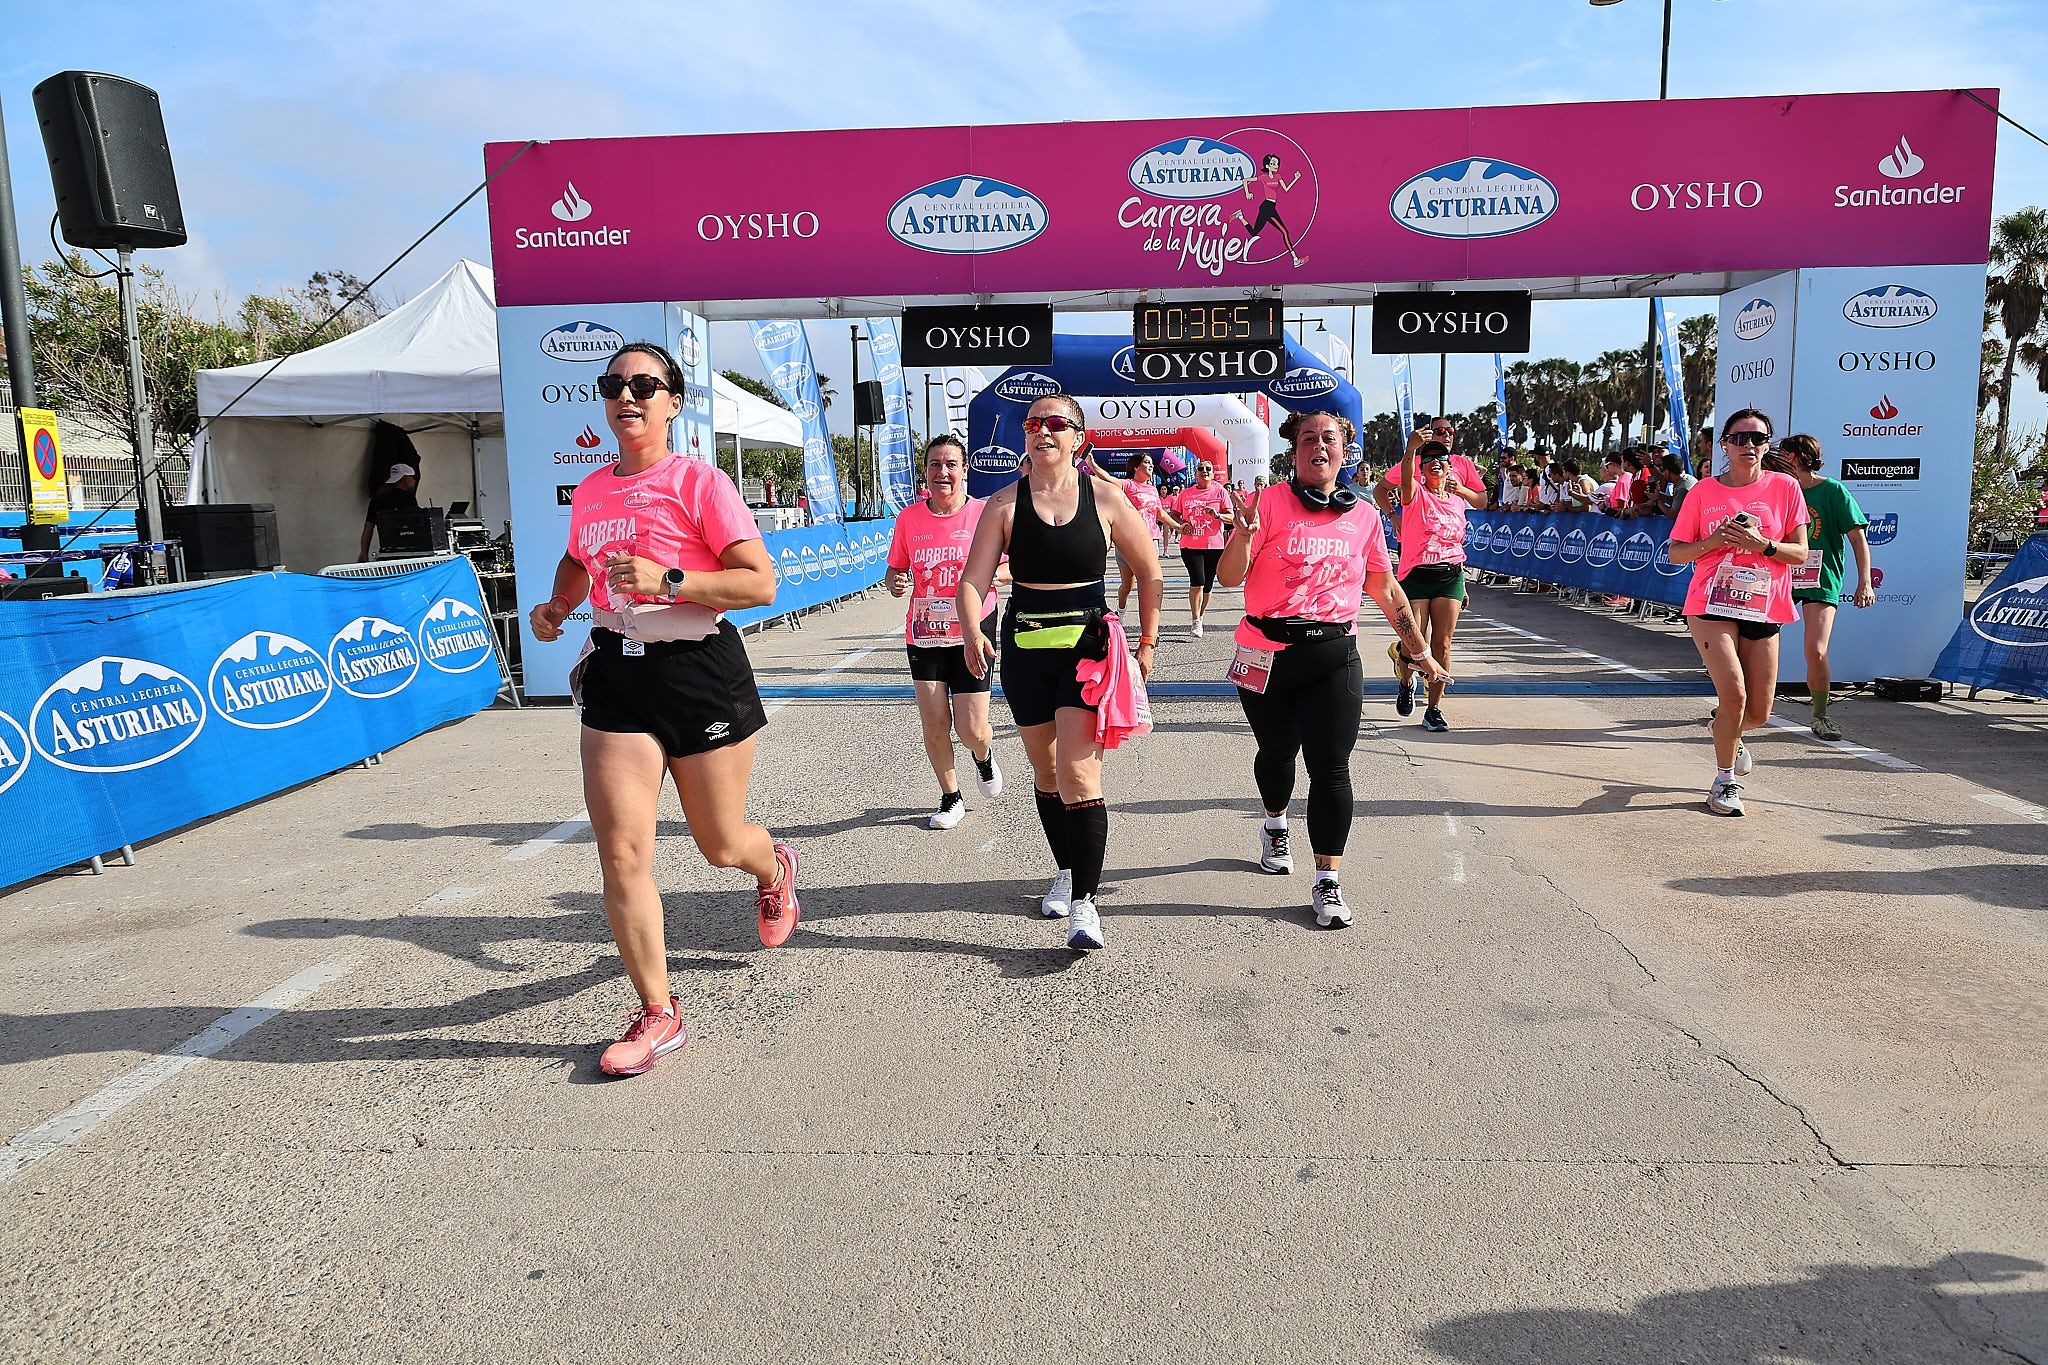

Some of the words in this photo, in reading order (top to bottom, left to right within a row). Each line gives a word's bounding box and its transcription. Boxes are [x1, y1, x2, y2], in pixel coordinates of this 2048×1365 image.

[1157, 158, 1198, 166] CENTRAL
[1201, 157, 1242, 165] LECHERA
[1138, 161, 1246, 185] ASTURIANA
[1428, 187, 1483, 195] CENTRAL
[1487, 184, 1541, 193] LECHERA
[1630, 180, 1763, 212] OYSHO
[1833, 182, 1966, 208] Santander
[923, 203, 974, 211] CENTRAL
[978, 202, 1031, 210] LECHERA
[1117, 196, 1223, 229] Carrera
[1405, 189, 1545, 220] ASTURIANA
[697, 211, 820, 241] OYSHO
[899, 206, 1037, 236] ASTURIANA
[515, 226, 631, 249] Santander
[1143, 230, 1164, 252] de
[1166, 229, 1181, 251] la
[1177, 223, 1261, 276] Mujer
[1849, 301, 1931, 318] ASTURIANA
[1398, 311, 1509, 335] OYSHO
[1737, 314, 1773, 334] ASTURIANA
[547, 338, 620, 353] ASTURIANA
[926, 326, 1031, 349] OYSHO
[1141, 349, 1279, 380] OYSHO
[1731, 357, 1775, 384] OYSHO
[1838, 350, 1937, 372] OYSHO
[542, 384, 605, 404] OYSH
[999, 383, 1057, 396] ASTURIANA
[1275, 380, 1335, 392] ASTURIANA
[1099, 398, 1196, 420] OYSHO
[1222, 418, 1252, 426] OYSHO
[1843, 422, 1924, 437] Santander
[1095, 428, 1123, 439] Sports
[1134, 428, 1178, 437] Santander
[554, 451, 620, 464] Santande
[972, 458, 1018, 468] ASTURIANA
[1238, 457, 1266, 465] OYSHO
[1846, 463, 1914, 478] Neutrogena
[912, 534, 934, 542] OYSHO
[1730, 589, 1753, 601] 016
[1877, 593, 1917, 606] energy
[1976, 597, 2048, 629] ASTURI
[930, 621, 951, 630] 016
[1306, 629, 1324, 637] FILA
[426, 629, 489, 660] ASTURIANA
[235, 662, 275, 679] CENTRAL
[277, 656, 315, 670] LECHERA
[338, 646, 416, 684] ASTURIANA
[71, 694, 129, 714] CENTRAL
[131, 683, 184, 702] LECHERA
[222, 667, 328, 714] ASTURIANA
[52, 697, 199, 756] ASTURIANA
[708, 730, 730, 741] umbro
